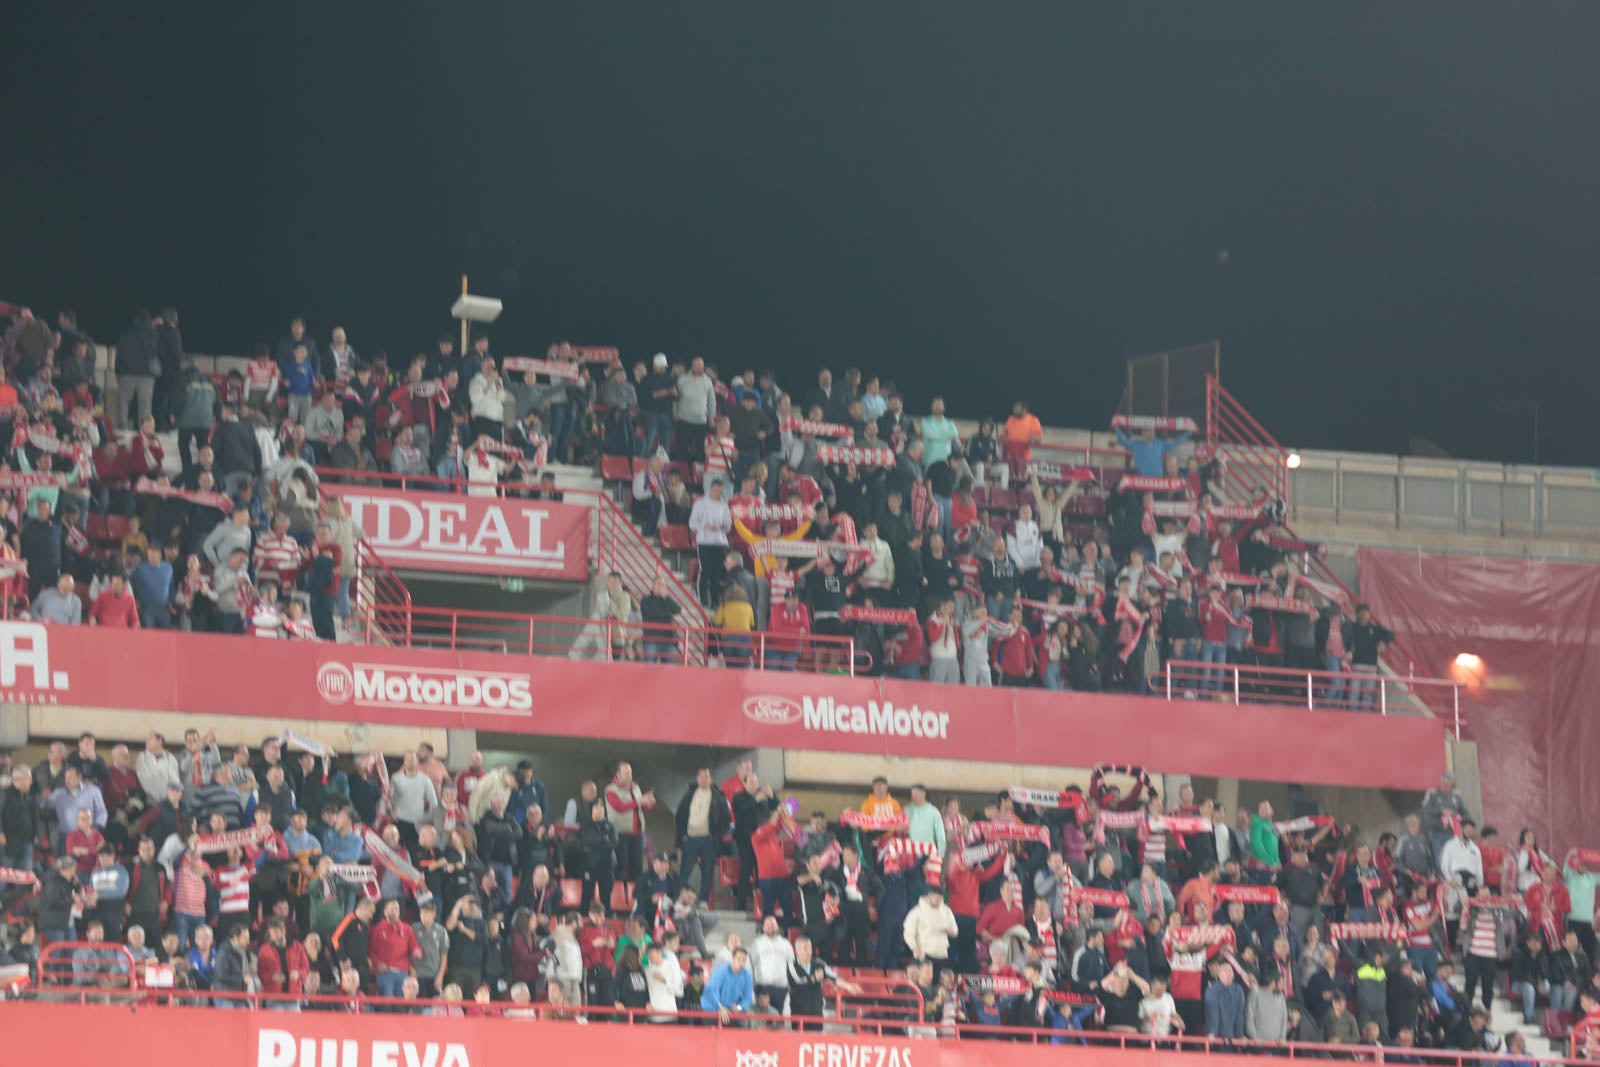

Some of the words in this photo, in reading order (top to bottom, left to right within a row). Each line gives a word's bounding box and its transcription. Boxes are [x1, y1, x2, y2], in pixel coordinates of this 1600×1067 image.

[343, 495, 564, 559] IDEAL
[353, 668, 533, 710] MotorDOS
[802, 695, 949, 739] MicaMotor
[799, 1043, 911, 1067] CERVEZAS
